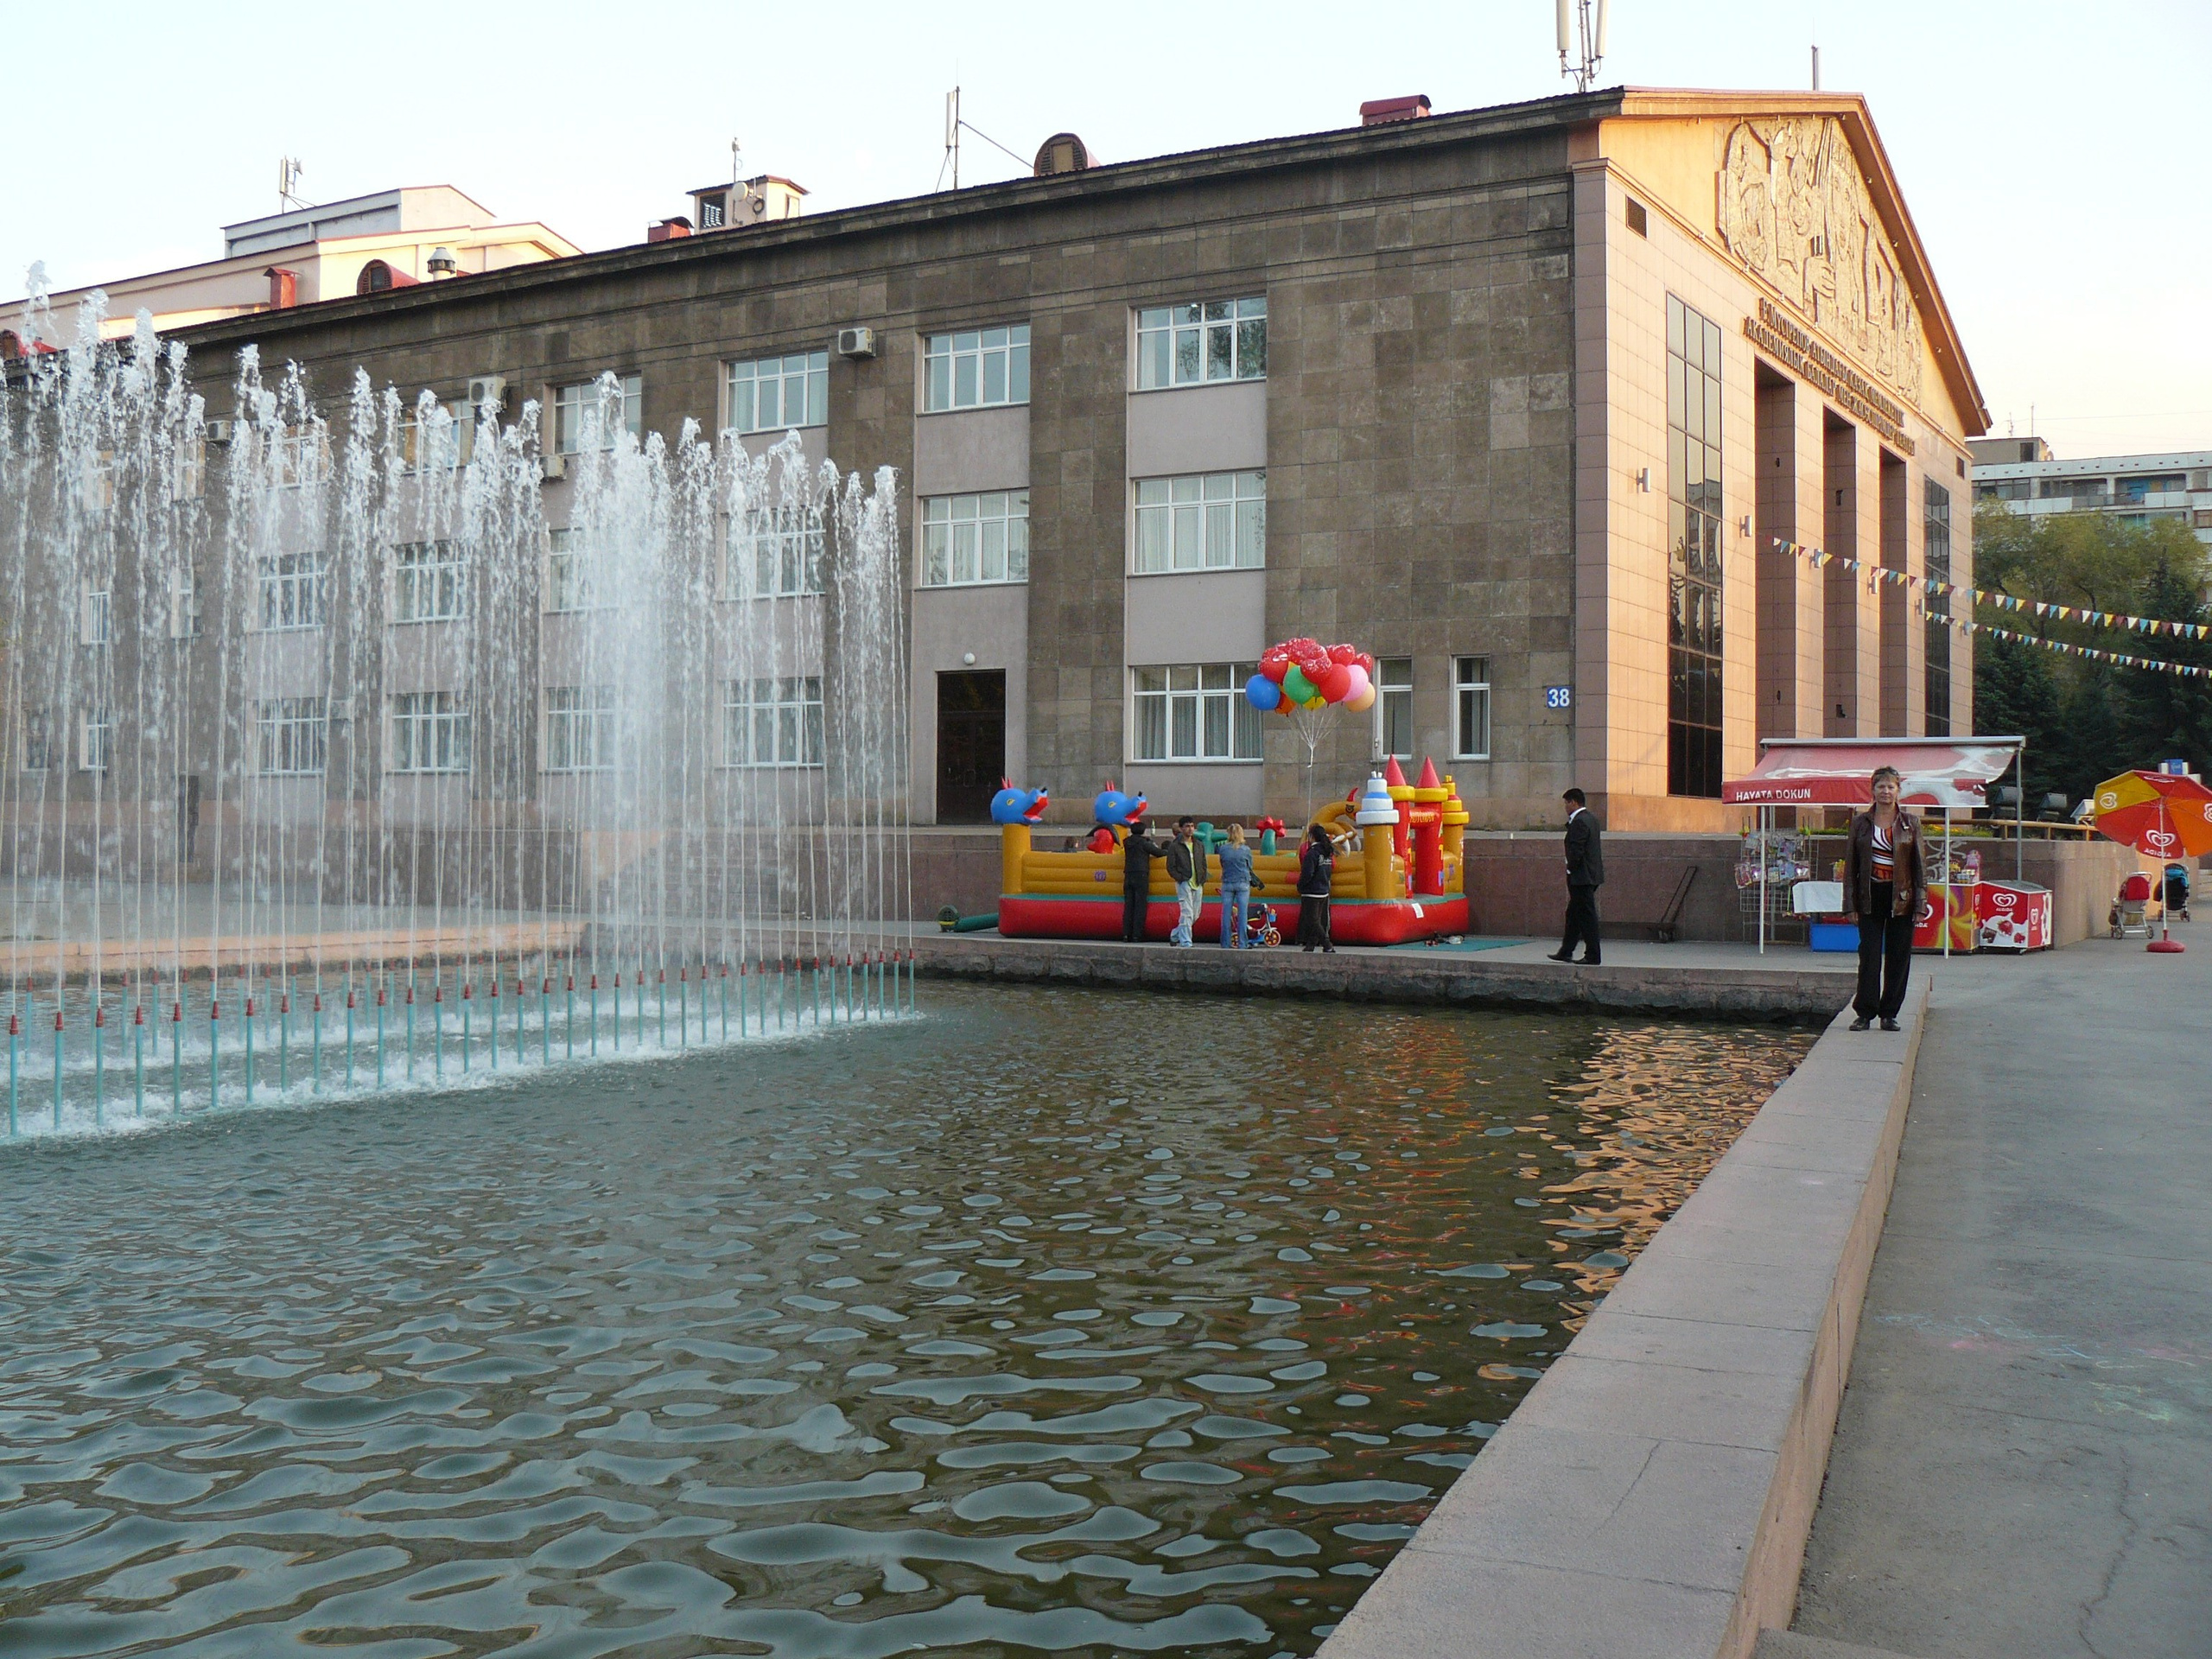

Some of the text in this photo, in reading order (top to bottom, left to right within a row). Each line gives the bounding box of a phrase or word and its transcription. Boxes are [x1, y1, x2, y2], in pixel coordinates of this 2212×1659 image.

[1548, 688, 1570, 708] 38
[1736, 788, 1811, 802] HAYATA DOKUN
